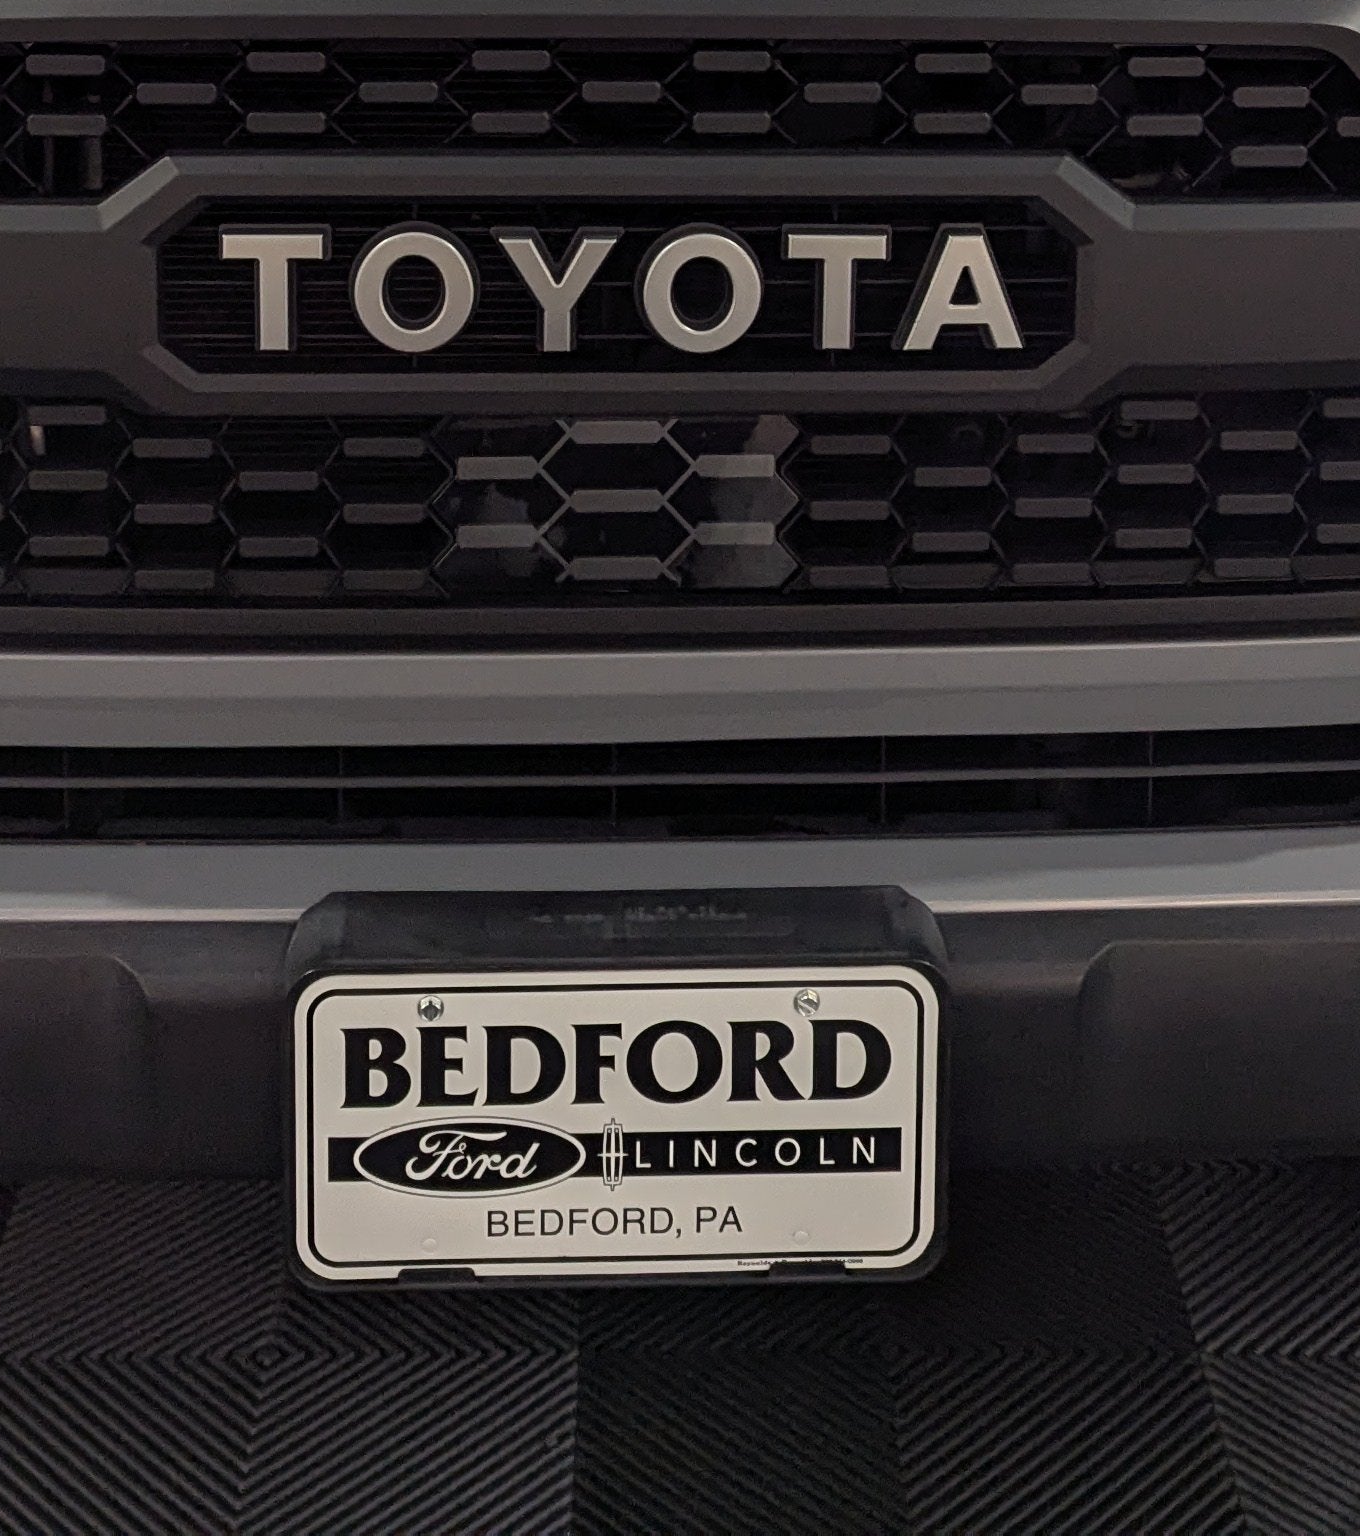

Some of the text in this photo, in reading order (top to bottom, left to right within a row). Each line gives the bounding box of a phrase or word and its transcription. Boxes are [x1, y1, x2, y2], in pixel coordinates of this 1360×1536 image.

[220, 230, 1024, 353] TOYOTA
[340, 1019, 892, 1109] BEDFORD
[404, 1128, 541, 1182] Ford
[635, 1136, 876, 1169] LINCOLN
[487, 1205, 743, 1239] BEDFORD, PA
